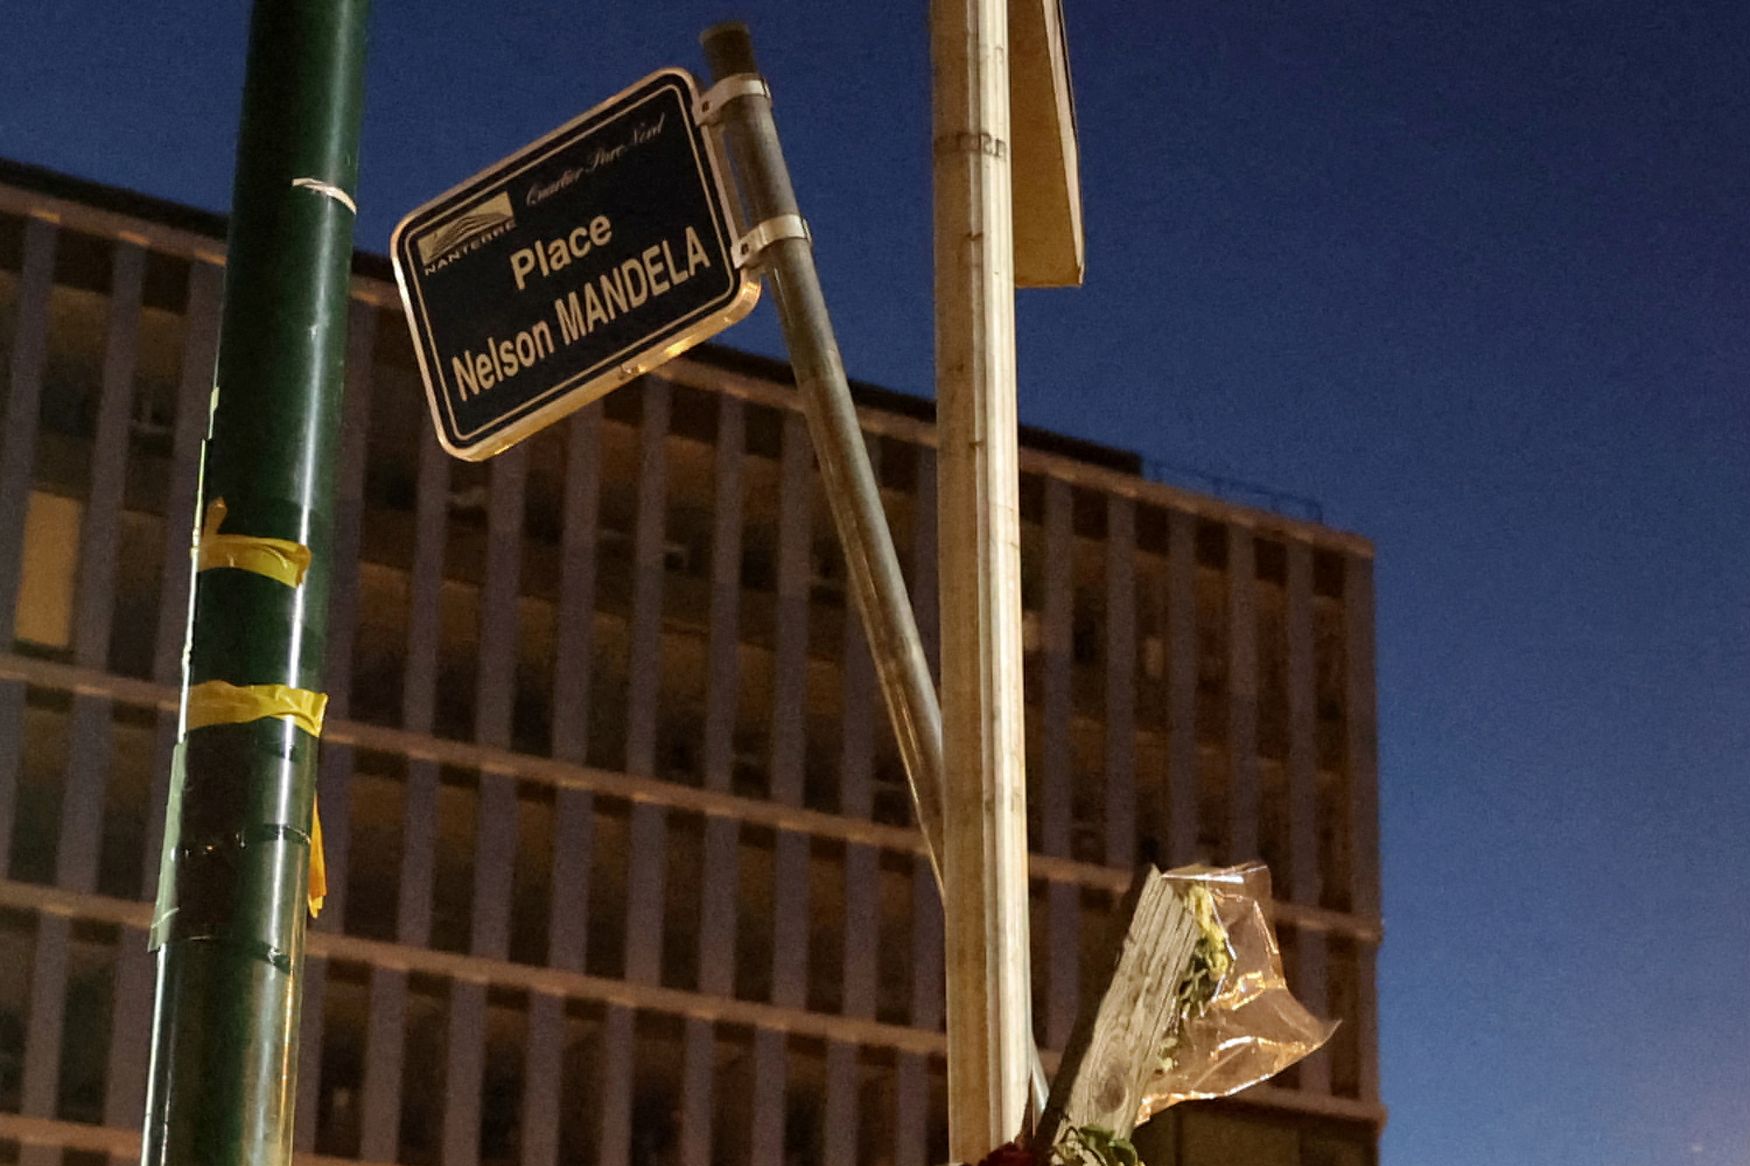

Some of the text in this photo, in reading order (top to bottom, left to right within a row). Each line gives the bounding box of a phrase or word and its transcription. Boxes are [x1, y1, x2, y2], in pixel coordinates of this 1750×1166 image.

[424, 221, 517, 276] NANTERRE
[511, 214, 614, 290] Place
[451, 226, 710, 401] Nelson MANDELA
